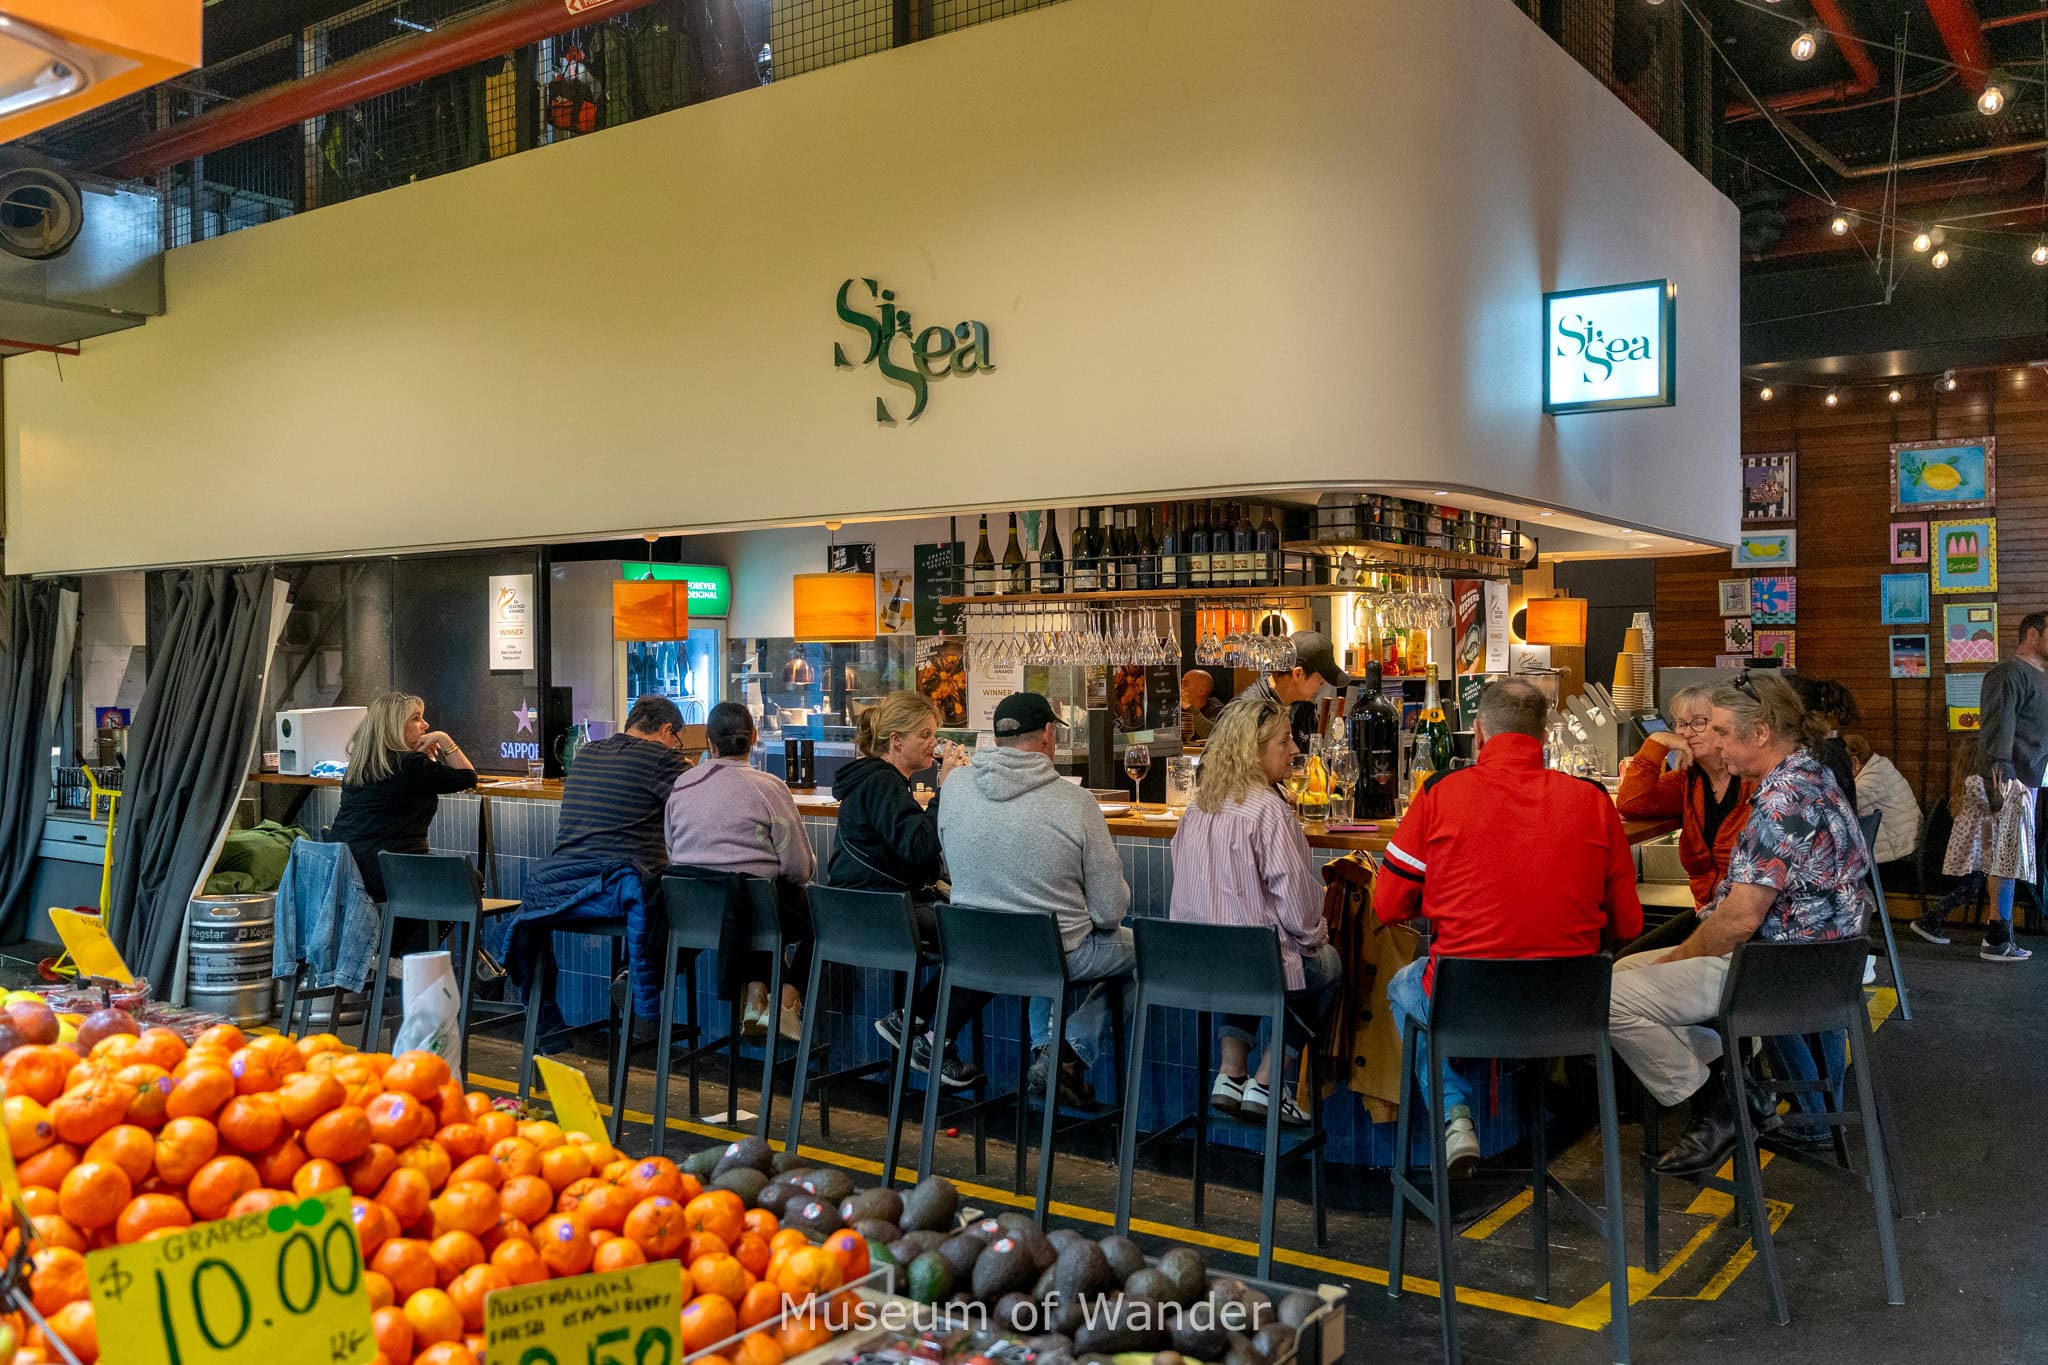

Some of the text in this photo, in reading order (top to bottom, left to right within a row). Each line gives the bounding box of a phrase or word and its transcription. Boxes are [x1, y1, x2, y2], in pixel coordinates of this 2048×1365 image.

[500, 628, 524, 636] WINNER
[982, 688, 1013, 697] WINNER
[192, 927, 225, 940] Kegstar
[162, 1216, 269, 1263] GRAPES
